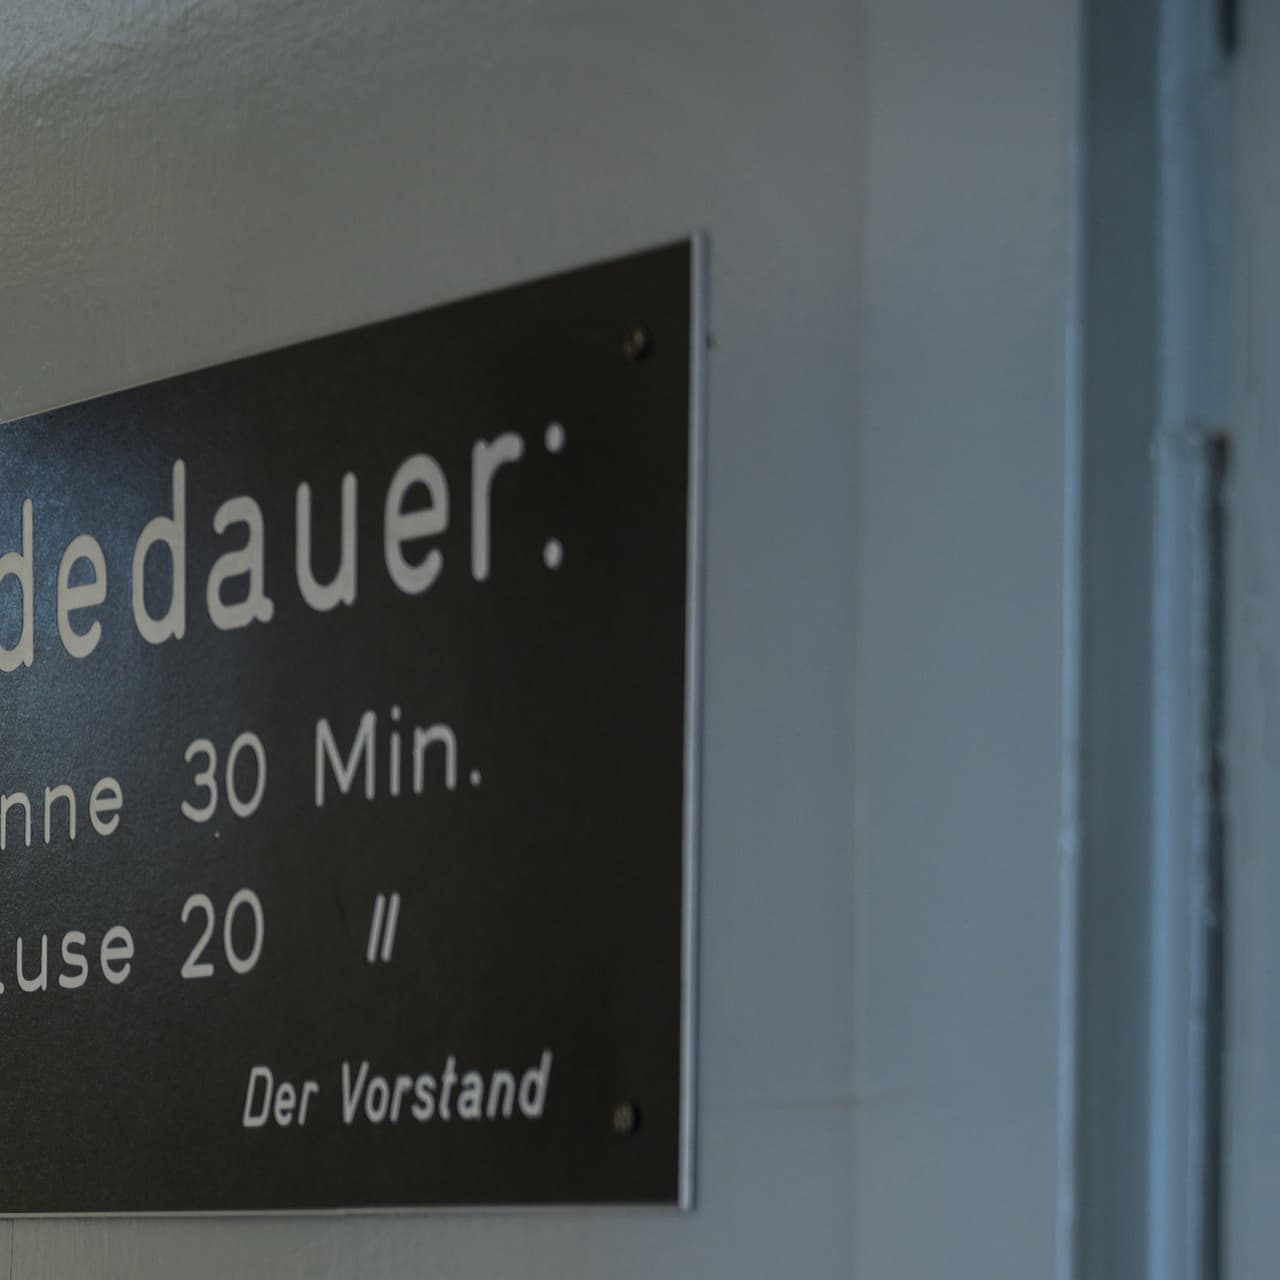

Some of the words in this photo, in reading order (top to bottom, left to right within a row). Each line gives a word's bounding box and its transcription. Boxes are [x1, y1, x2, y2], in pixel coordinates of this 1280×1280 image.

[180, 731, 268, 823] 30
[315, 705, 483, 808] Min.
[180, 888, 266, 979] 20
[241, 1066, 320, 1128] Der
[341, 1050, 553, 1124] Vorstand
